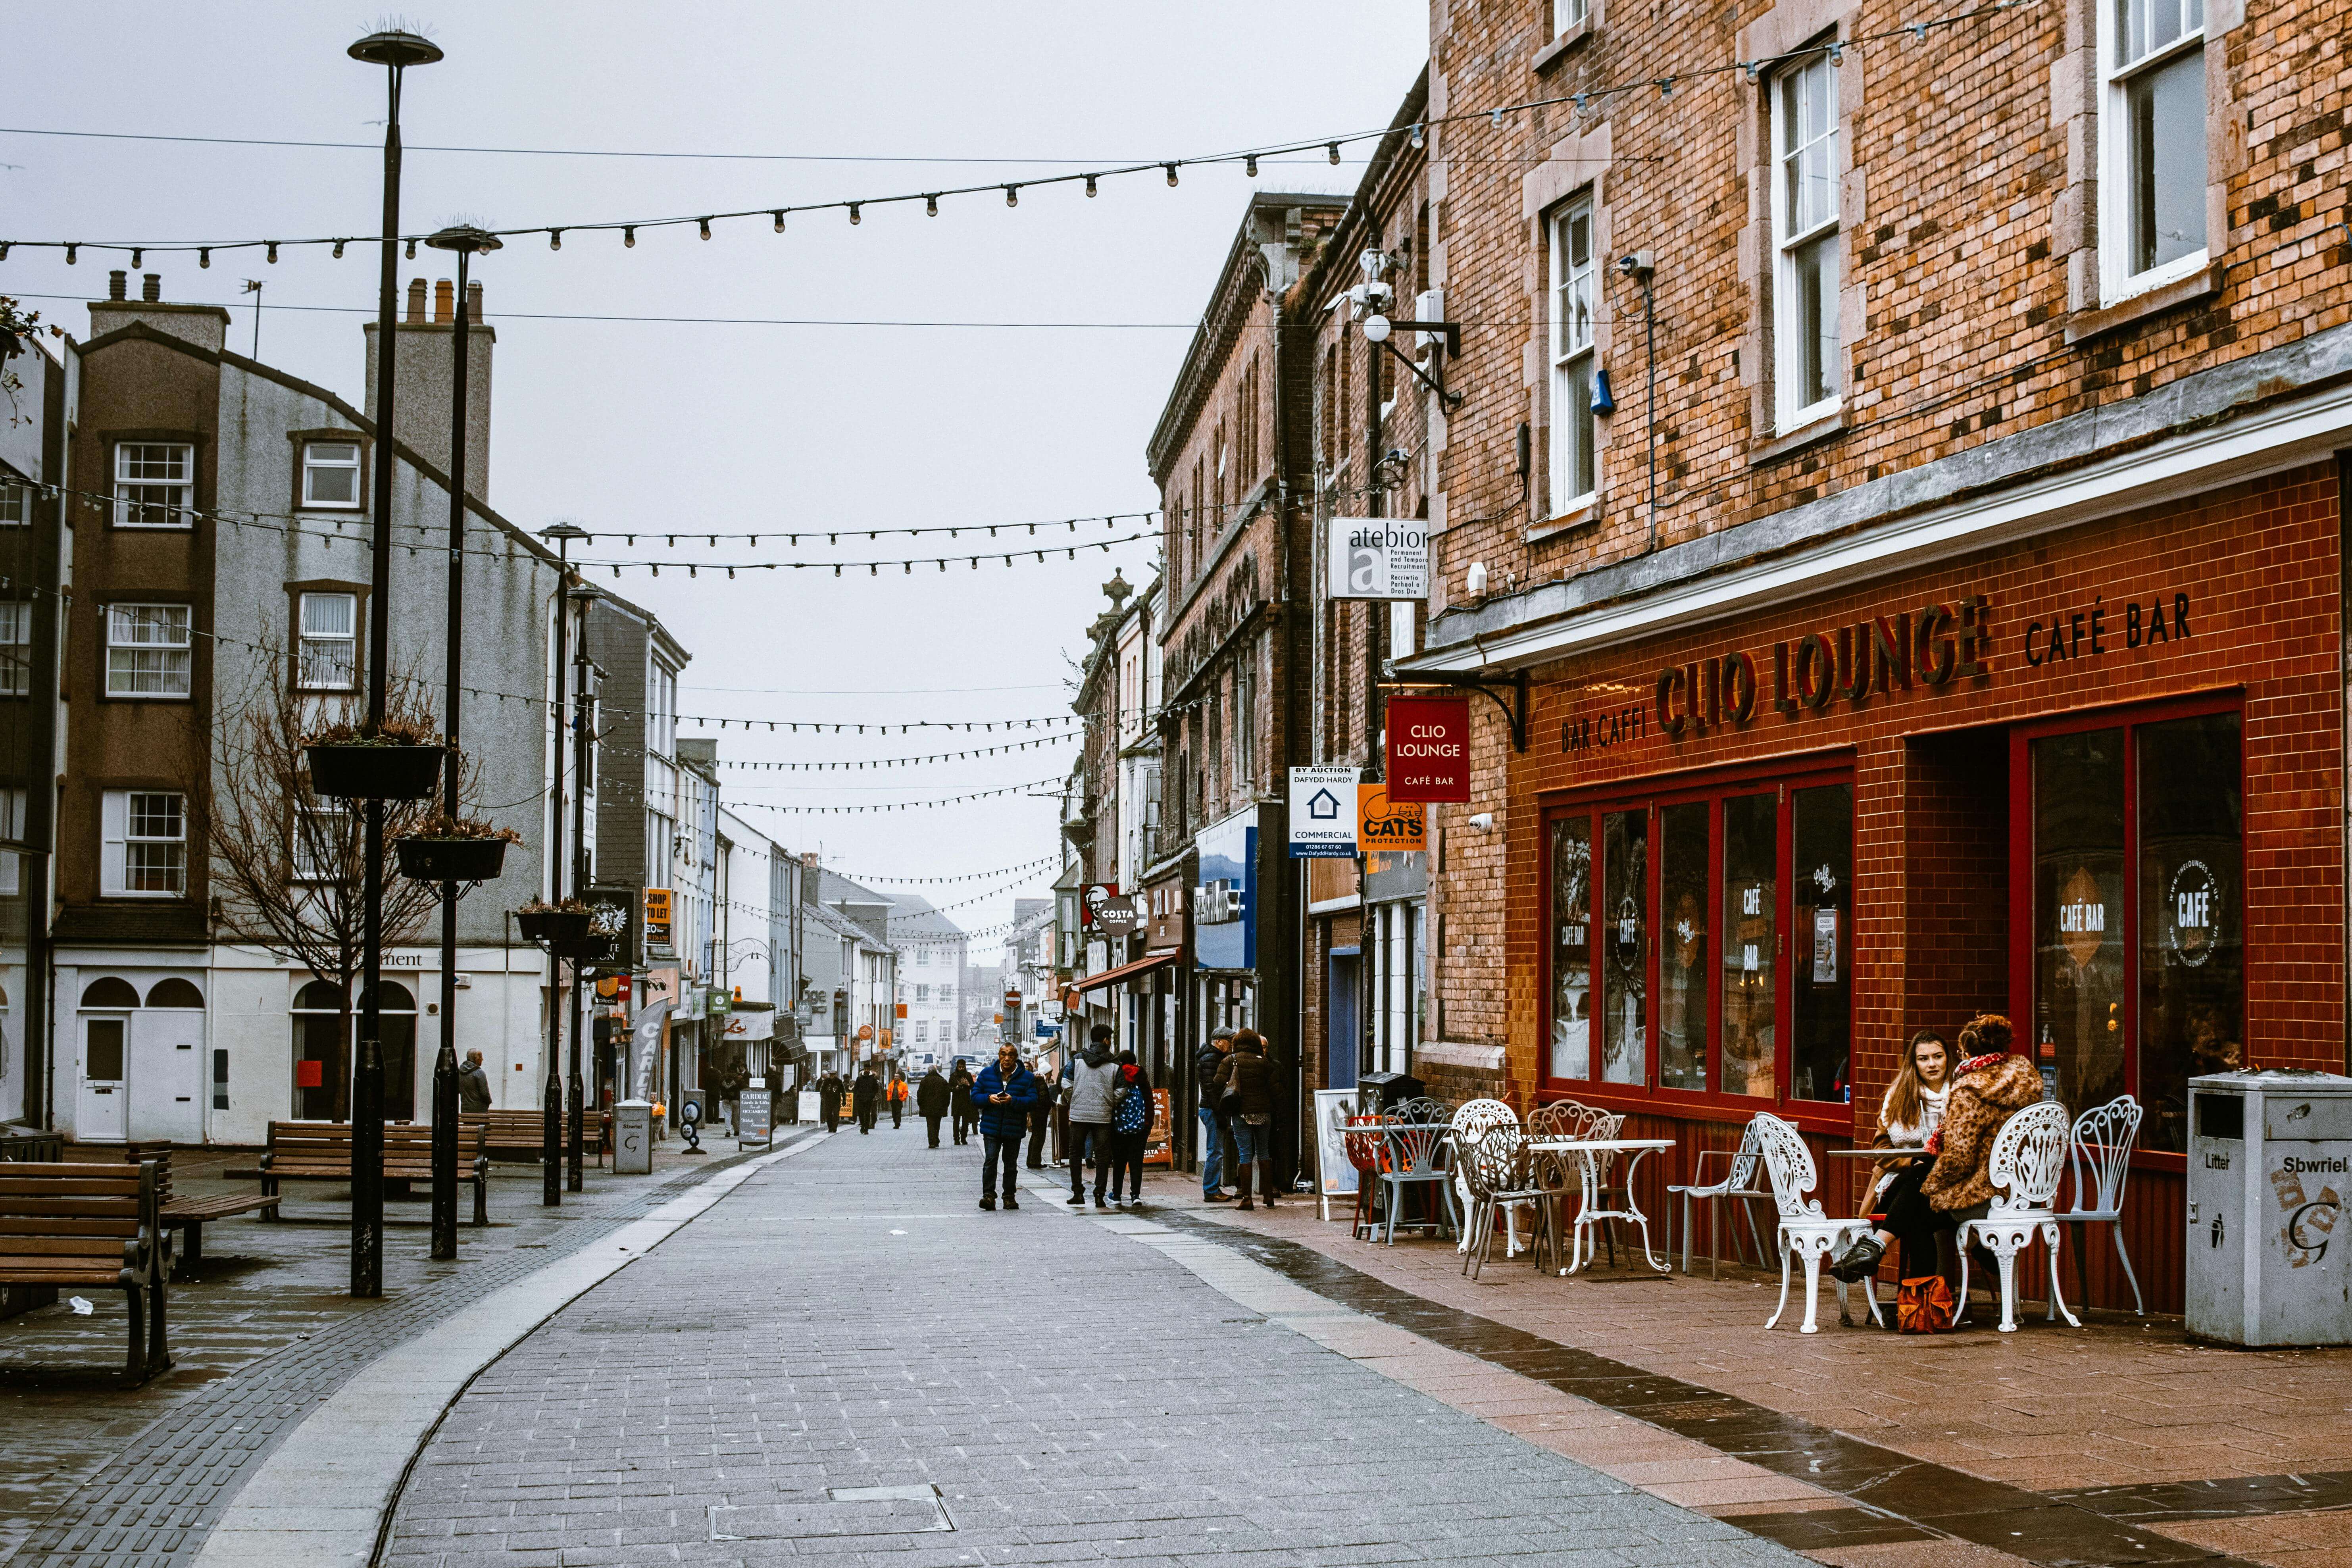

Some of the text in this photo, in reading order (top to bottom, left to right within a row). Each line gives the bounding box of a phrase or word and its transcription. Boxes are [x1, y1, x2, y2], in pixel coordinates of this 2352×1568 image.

[2025, 593, 2191, 667] CAFÉ BAR
[1656, 595, 1989, 734] CLIO LOUNGE
[1411, 725, 1446, 738] CLIO
[1562, 706, 1645, 753] BAR CAFFI
[1397, 744, 1460, 757] LOUNGE
[1405, 775, 1430, 785] CAFÉ
[1364, 819, 1423, 837] CATS
[648, 894, 666, 904] SHOP
[1744, 883, 1760, 915] CAFÉ
[2178, 882, 2209, 928] CAFÉ
[647, 908, 667, 918] TO LET
[1102, 910, 1134, 919] COSTA
[2060, 897, 2104, 932] CAFÉ BAR
[1562, 921, 1584, 945] CAFÉ BAR
[1619, 913, 1635, 943] CAFÉ
[1744, 945, 1758, 971] BAR
[2206, 1153, 2230, 1170] Litter
[2283, 1157, 2347, 1173] Sbwriel
